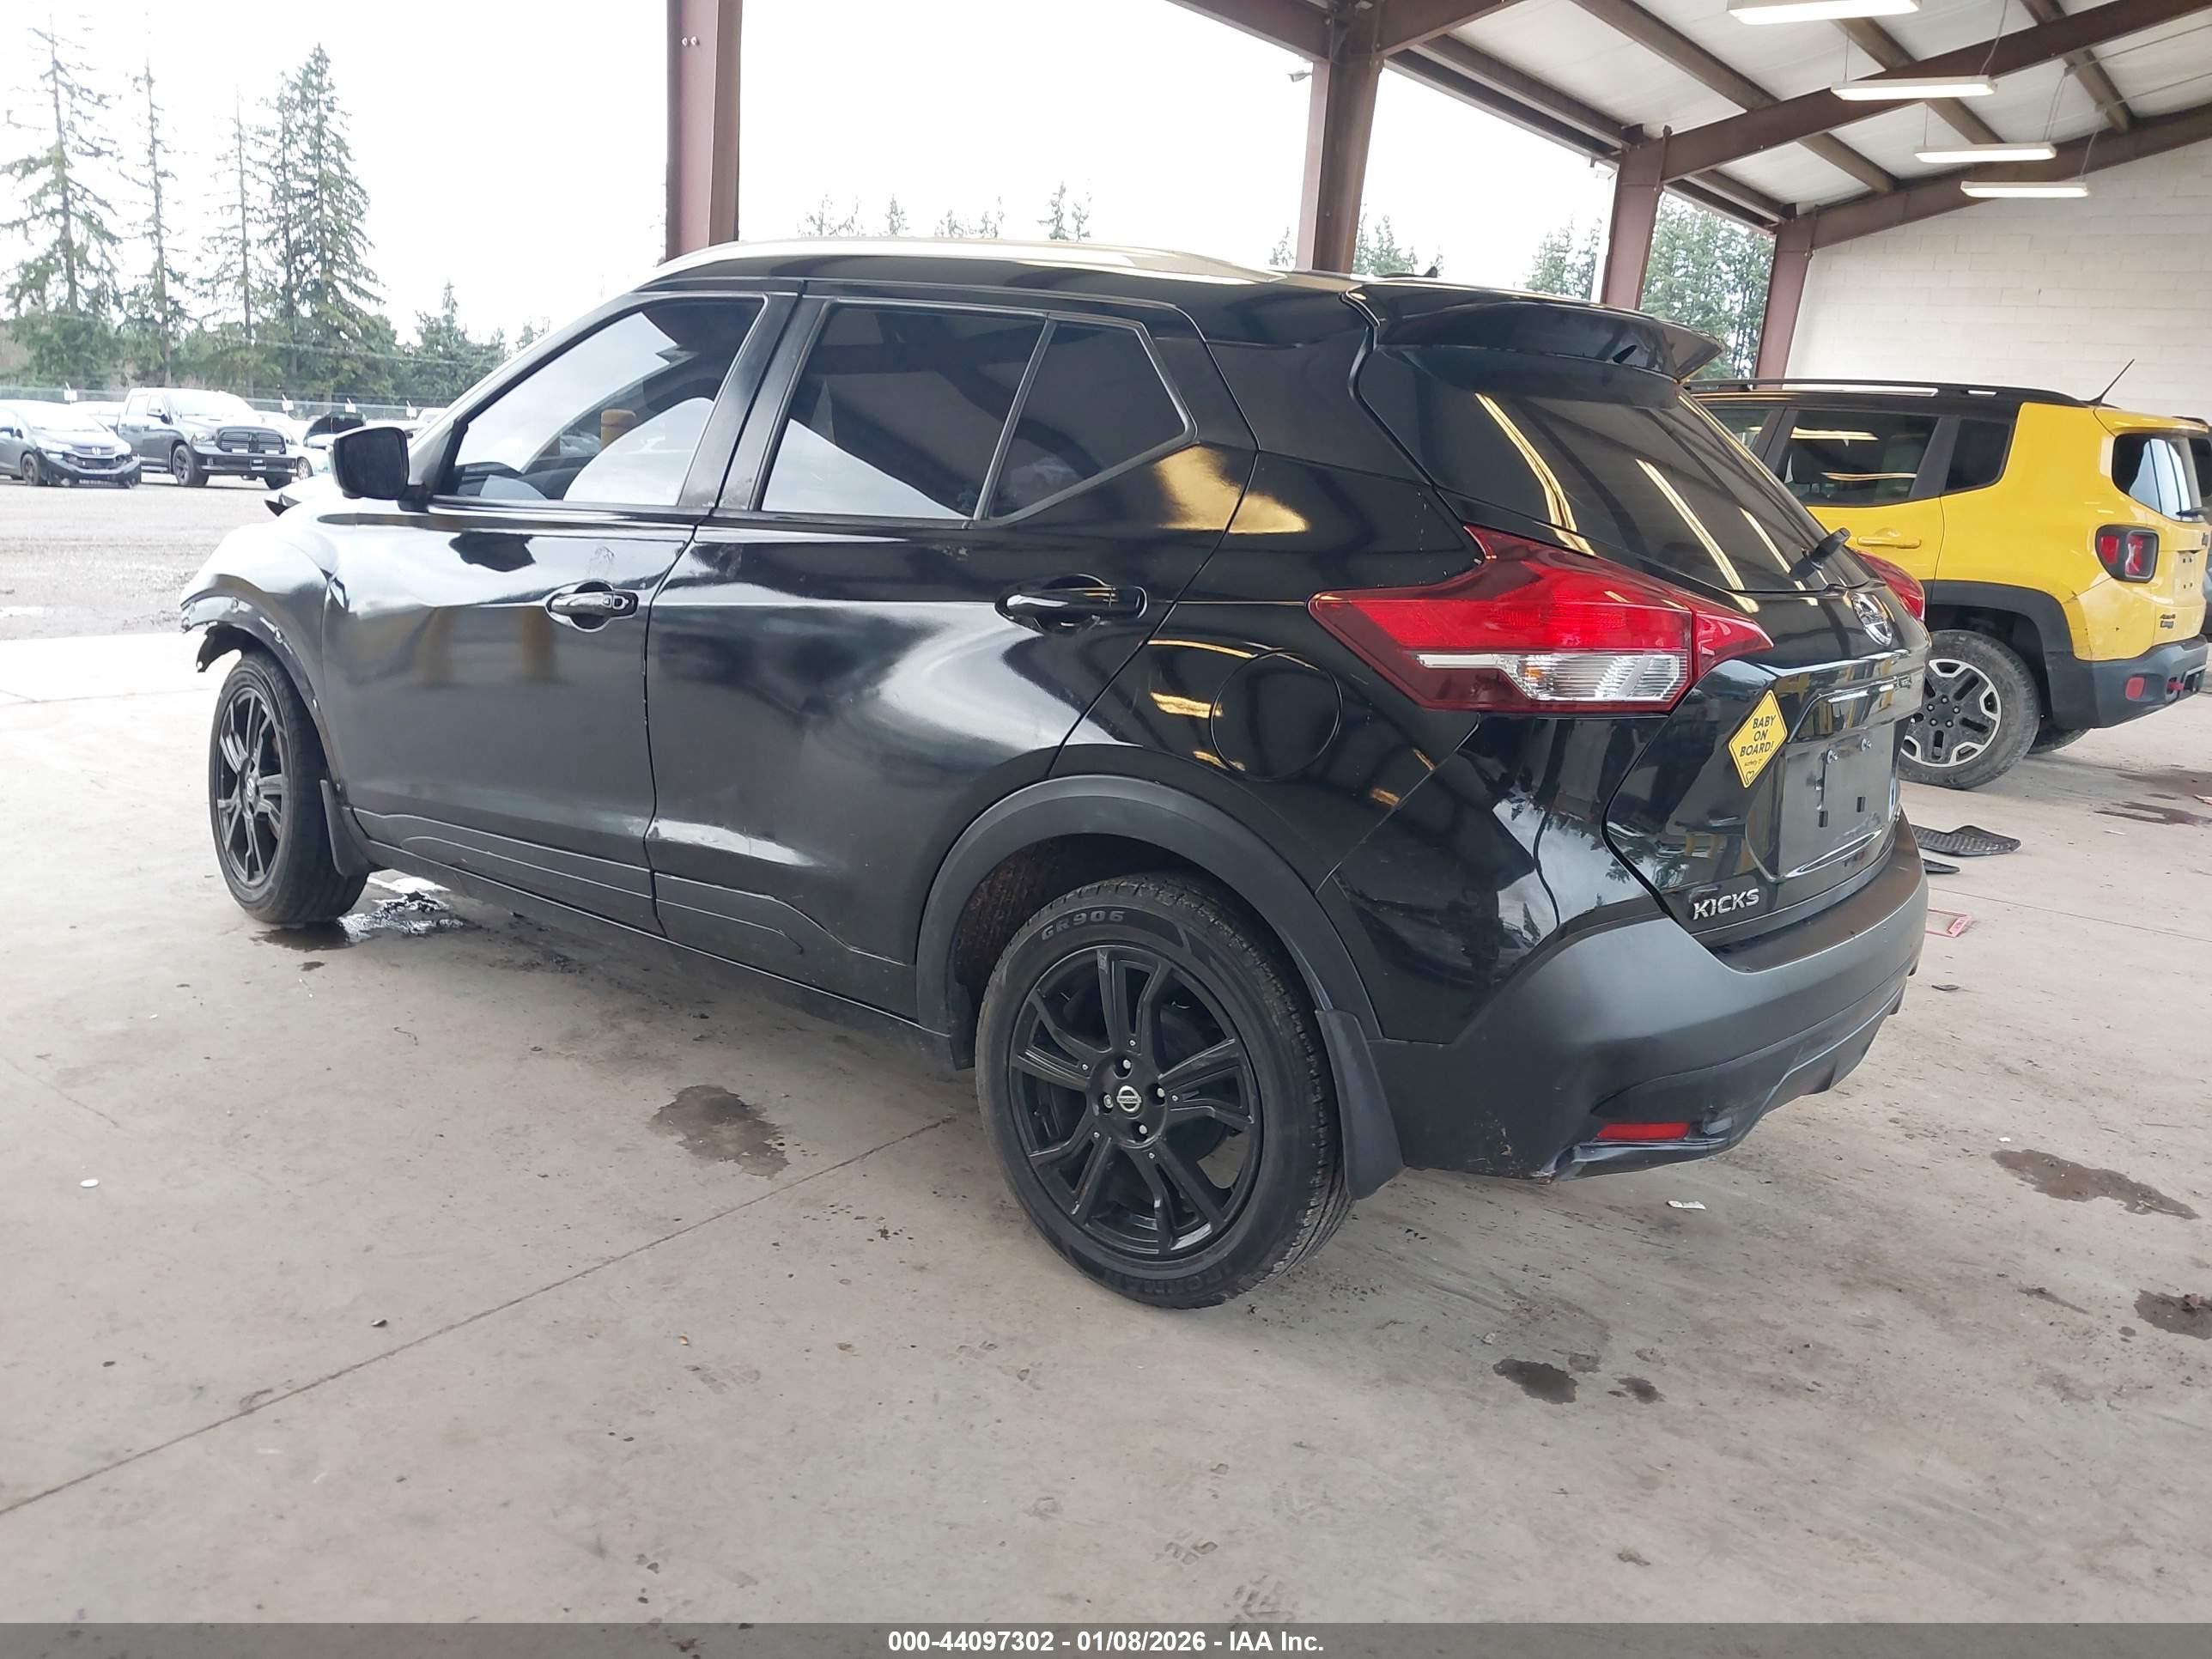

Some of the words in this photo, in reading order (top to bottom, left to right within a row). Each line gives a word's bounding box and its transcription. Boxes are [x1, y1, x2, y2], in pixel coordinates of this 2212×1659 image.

[1753, 714, 1776, 729] BABY
[1753, 729, 1768, 742] ON
[1740, 741, 1774, 757] BOARD!
[1692, 888, 1759, 921] KICKS
[1041, 910, 1126, 941] GR906
